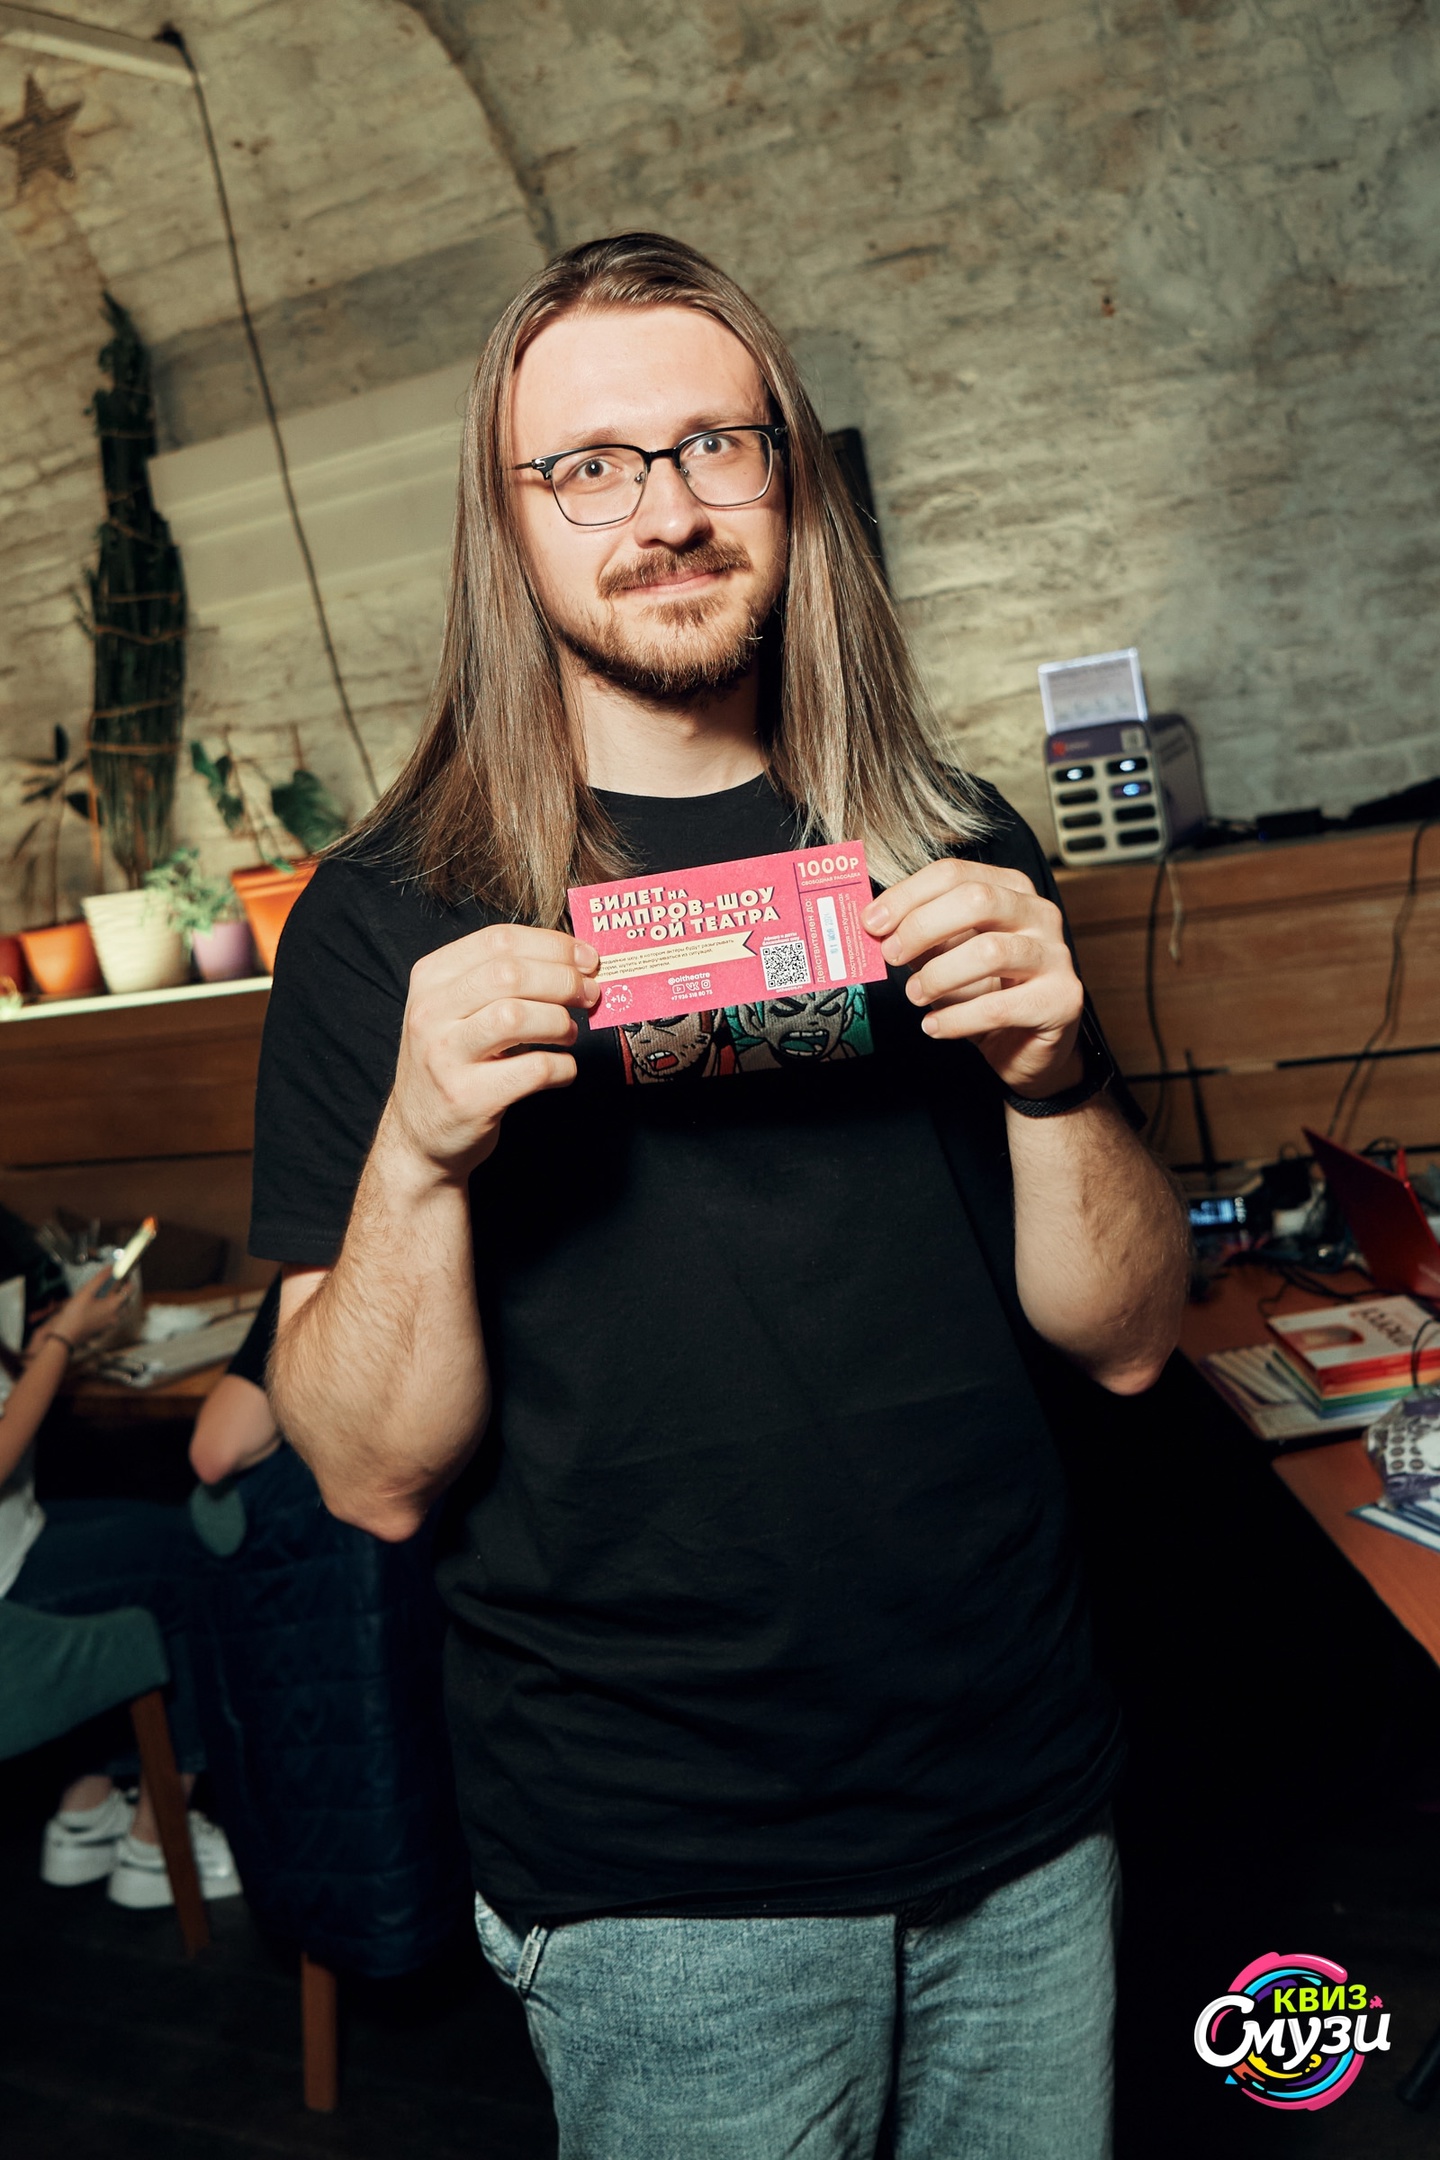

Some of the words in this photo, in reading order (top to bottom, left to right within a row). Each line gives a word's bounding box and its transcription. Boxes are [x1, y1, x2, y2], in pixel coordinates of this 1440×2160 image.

[589, 887, 665, 913] БИЛЕТ
[667, 889, 688, 900] НА
[592, 886, 774, 932] ИМПРОВ-ШОУ
[805, 898, 814, 913] до:
[626, 927, 646, 939] ОТ
[650, 918, 686, 941] ОЙ
[690, 906, 780, 933] ТЕАТРА
[808, 915, 826, 983] Действителен
[610, 993, 626, 1004] +16
